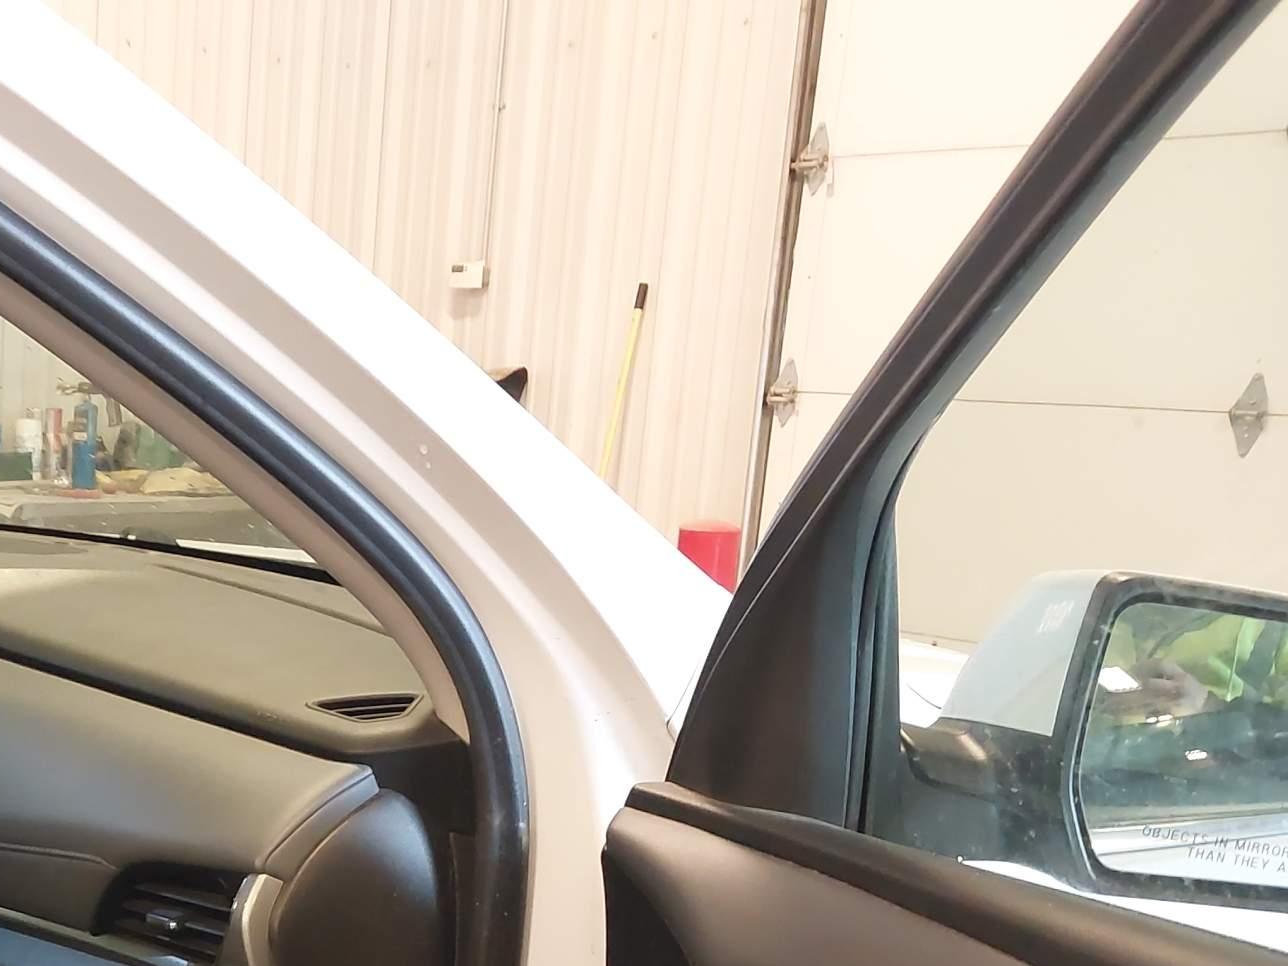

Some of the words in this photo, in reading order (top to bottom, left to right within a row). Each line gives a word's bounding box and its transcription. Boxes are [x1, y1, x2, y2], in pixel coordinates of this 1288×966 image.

[1142, 824, 1209, 844] OBJECTS
[1214, 836, 1229, 849] IN
[1187, 847, 1226, 864] THAN
[1234, 854, 1271, 871] THEY
